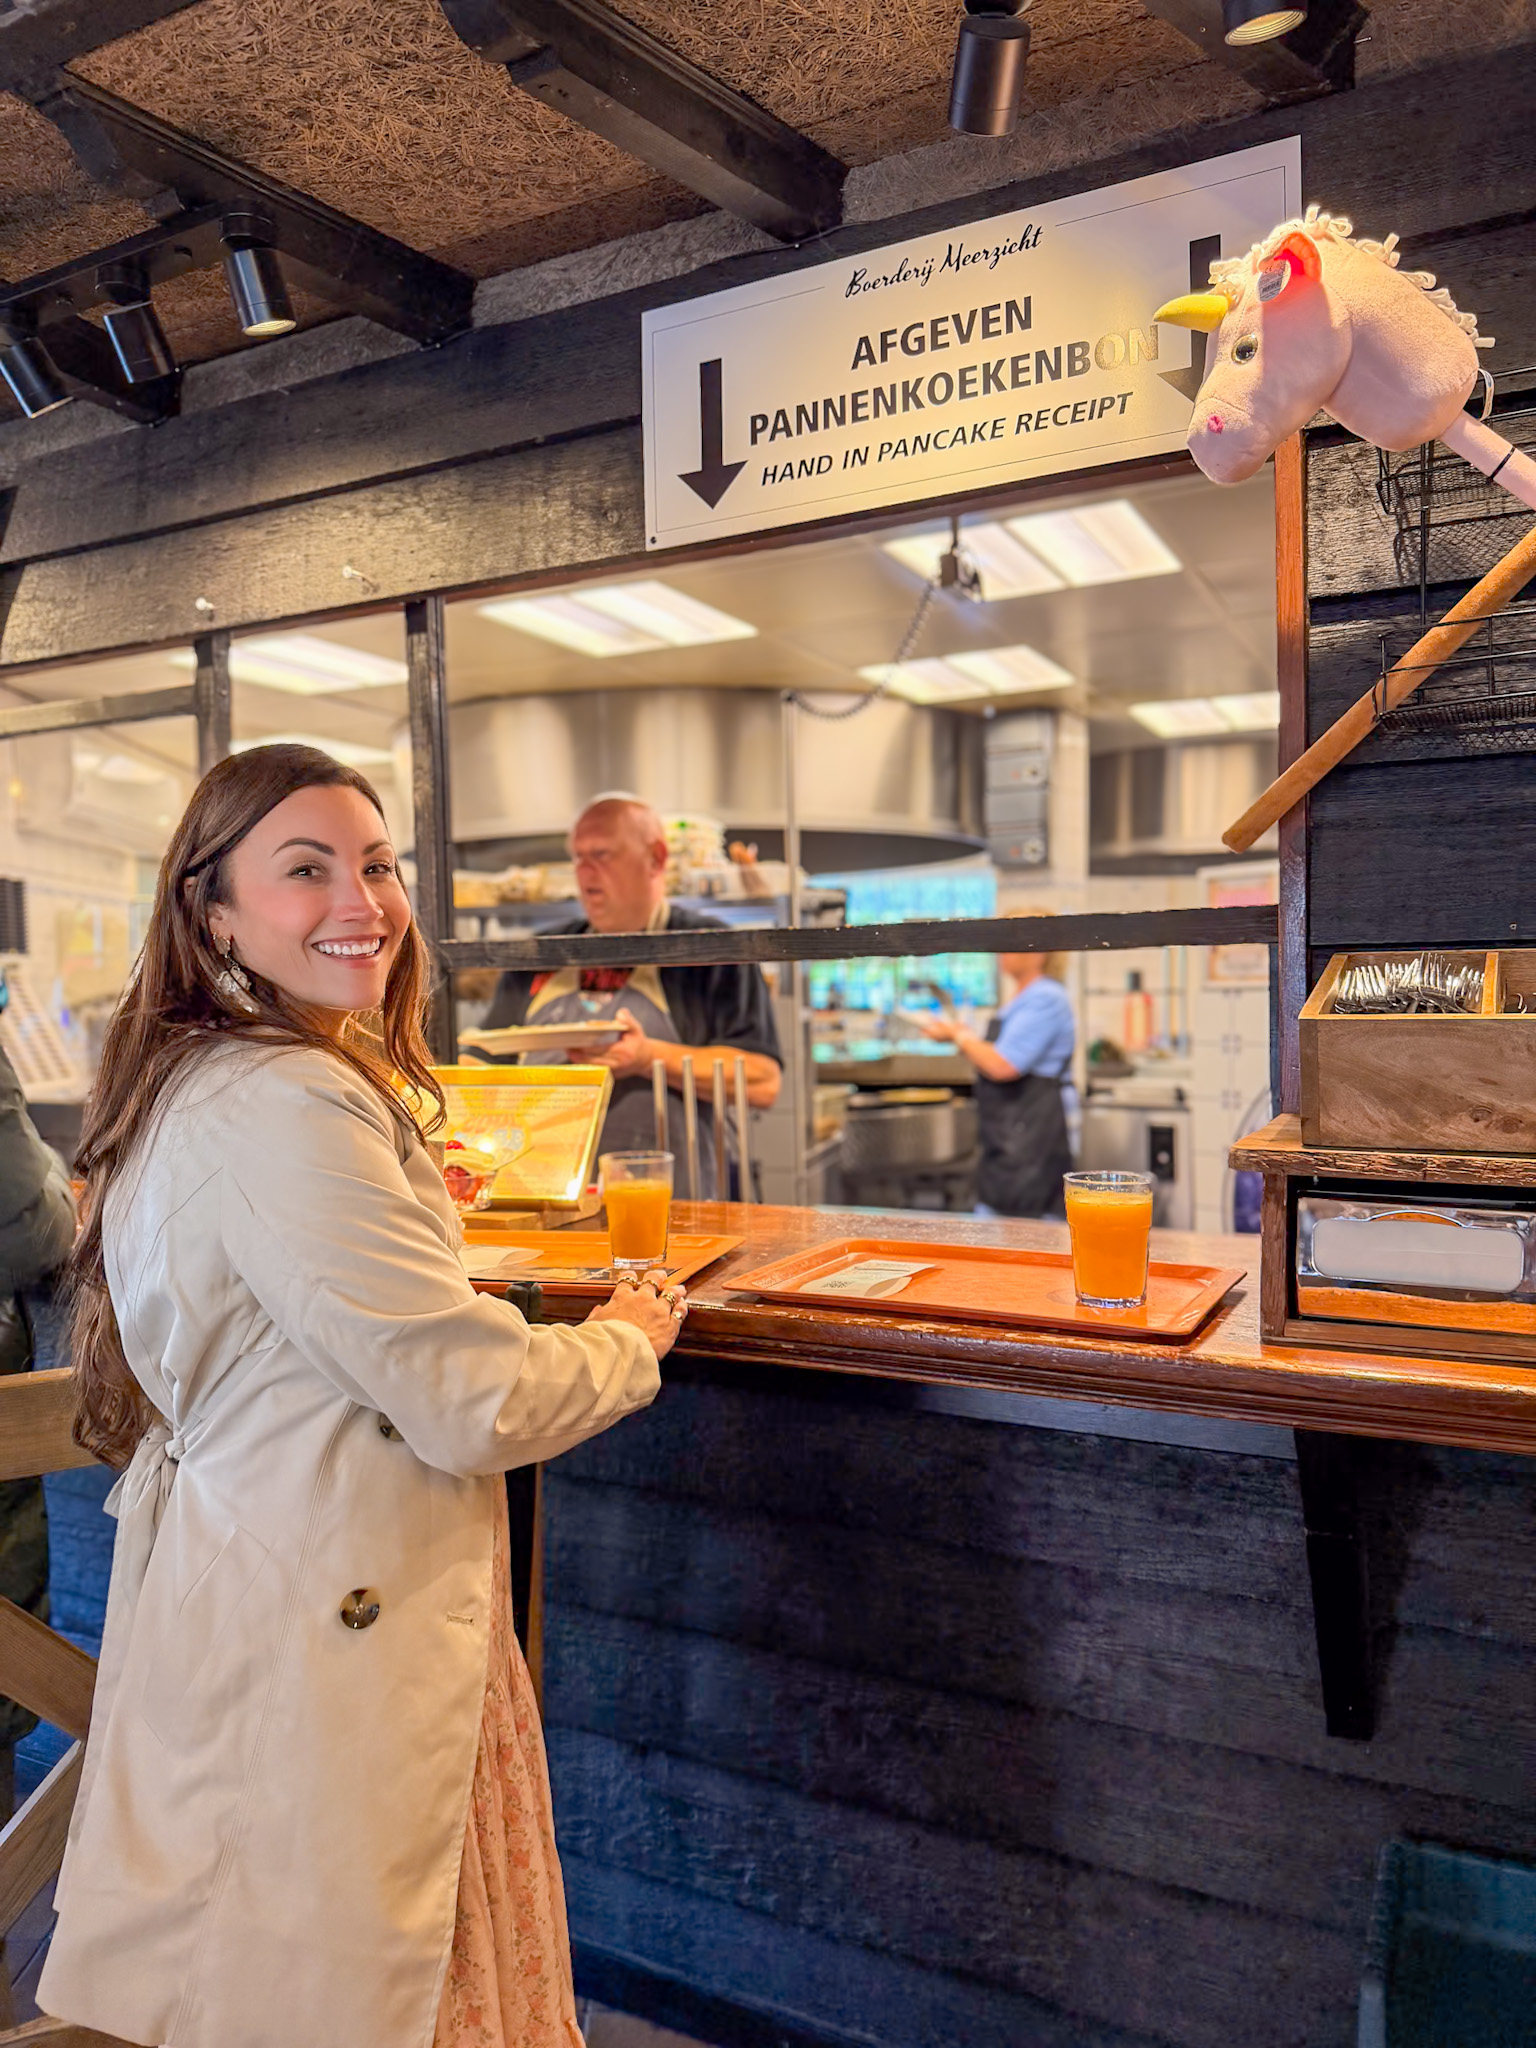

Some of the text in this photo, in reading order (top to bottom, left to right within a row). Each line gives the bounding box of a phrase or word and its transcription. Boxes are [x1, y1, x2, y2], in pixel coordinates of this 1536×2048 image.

[845, 224, 1043, 298] Boerderij Meerzicht
[851, 295, 1032, 370] AFGEVEN
[750, 324, 1159, 446] PANNENKOEKENBON
[762, 391, 1134, 486] HAND IN PANCAKE RECEIPT
